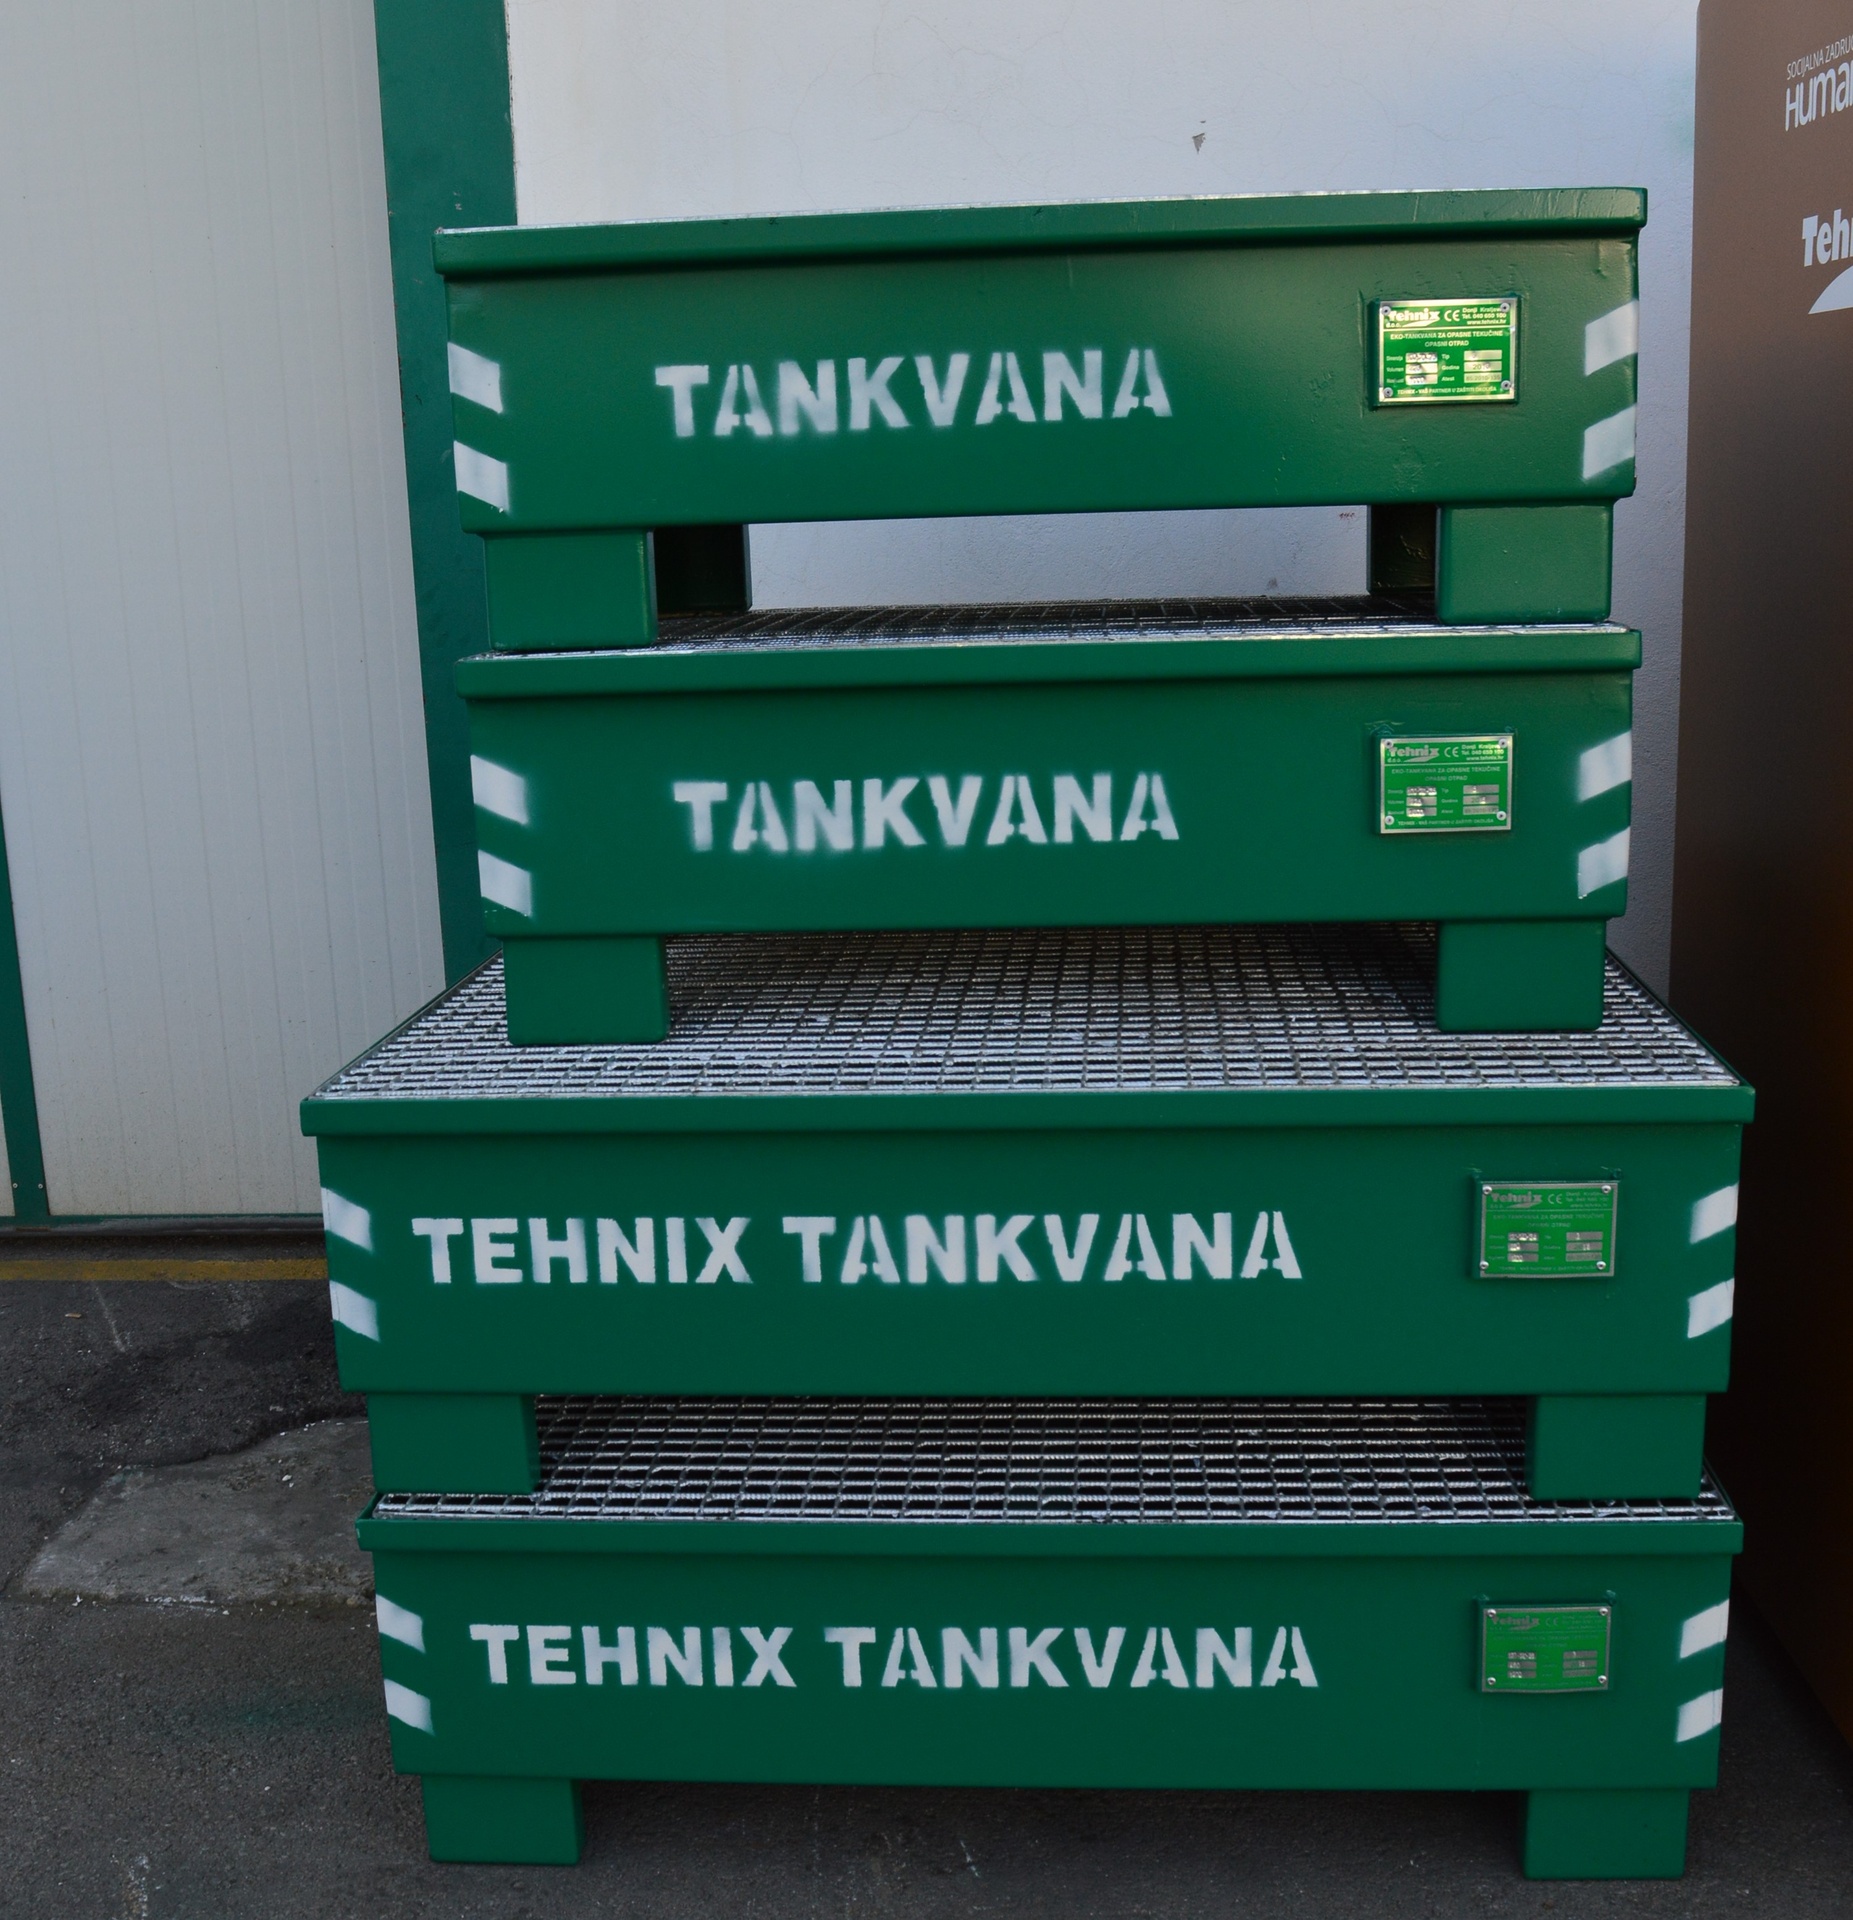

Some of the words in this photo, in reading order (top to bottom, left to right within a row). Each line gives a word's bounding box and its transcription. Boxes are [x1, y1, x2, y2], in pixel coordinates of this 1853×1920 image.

[1787, 49, 1824, 80] SOCIJALNA
[1444, 309, 1460, 322] CE
[655, 348, 1172, 438] TANKVANA
[1389, 744, 1440, 757] Tehnix
[1444, 746, 1459, 758] CE
[674, 773, 1179, 852] TANKVANA
[1547, 1193, 1563, 1205] CE
[412, 1216, 750, 1285] TEHNIX
[782, 1210, 1302, 1284] TANKVANA
[469, 1623, 796, 1688] TEHNIX
[825, 1625, 1318, 1689] TANKVANA
